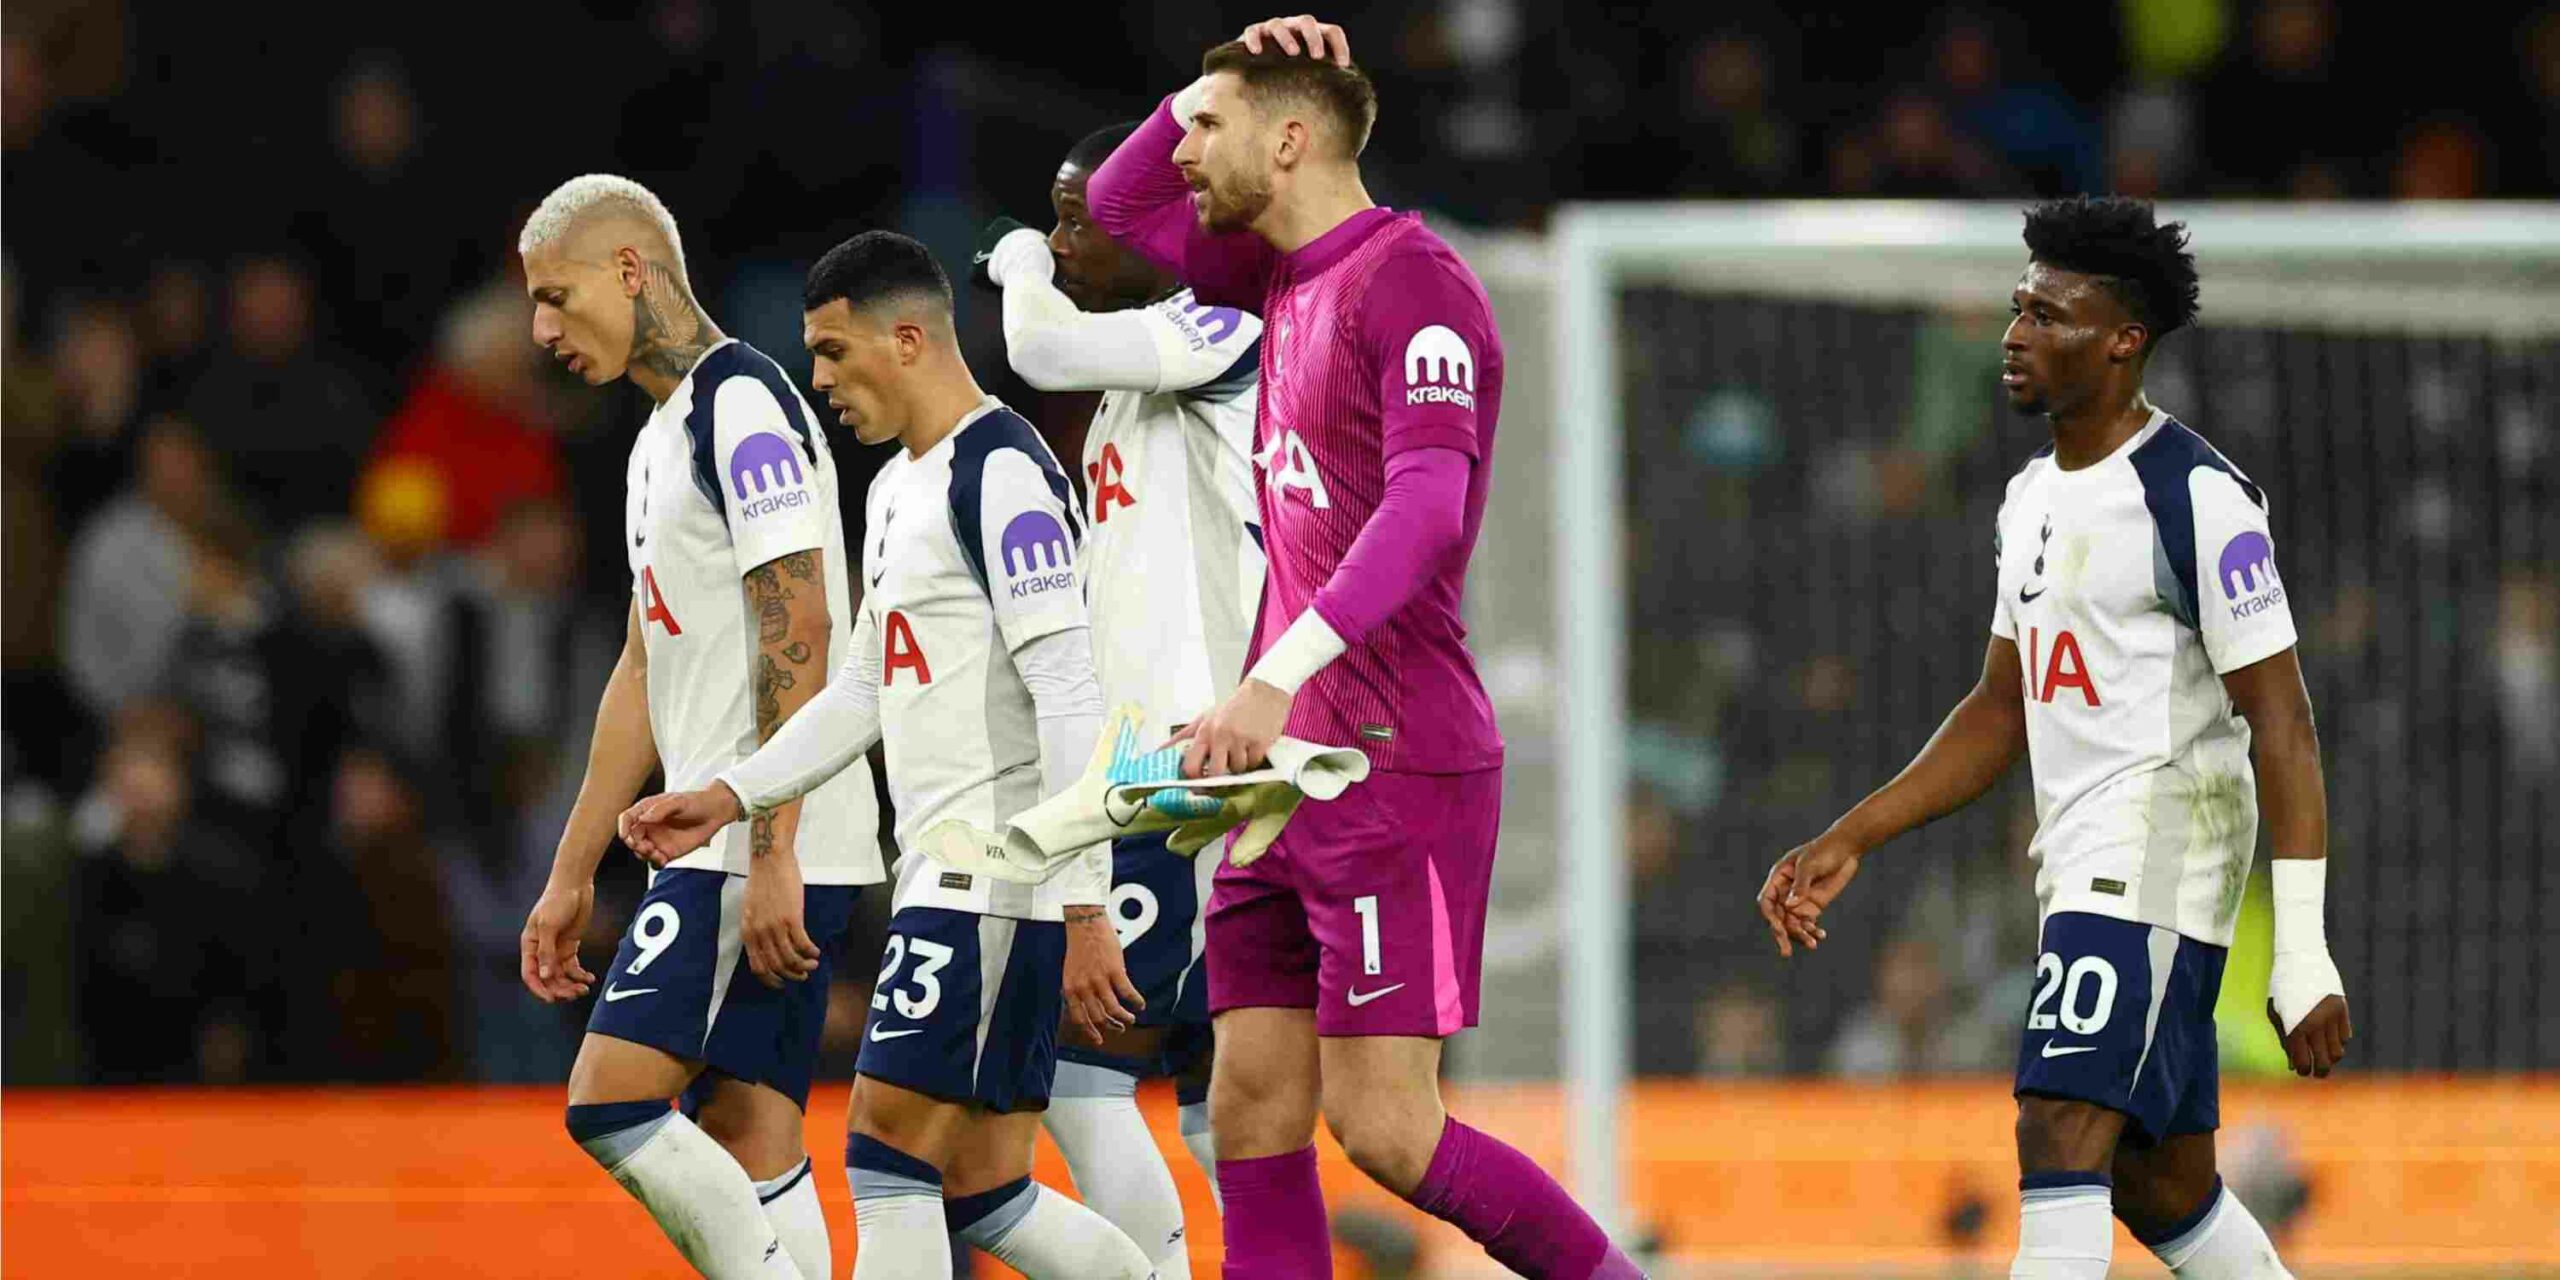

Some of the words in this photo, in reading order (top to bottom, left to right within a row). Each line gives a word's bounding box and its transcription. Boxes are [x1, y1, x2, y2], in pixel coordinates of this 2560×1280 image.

[1406, 385, 1474, 413] kraken
[742, 489, 811, 521] kraken
[1010, 572, 1078, 600] kraken
[2230, 587, 2283, 621] krake
[2022, 626, 2102, 707] IA
[985, 843, 1009, 861] VEN
[625, 901, 680, 975] 9
[1354, 895, 1380, 975] 1
[871, 934, 954, 1019] 23
[2027, 951, 2118, 1035] 20
